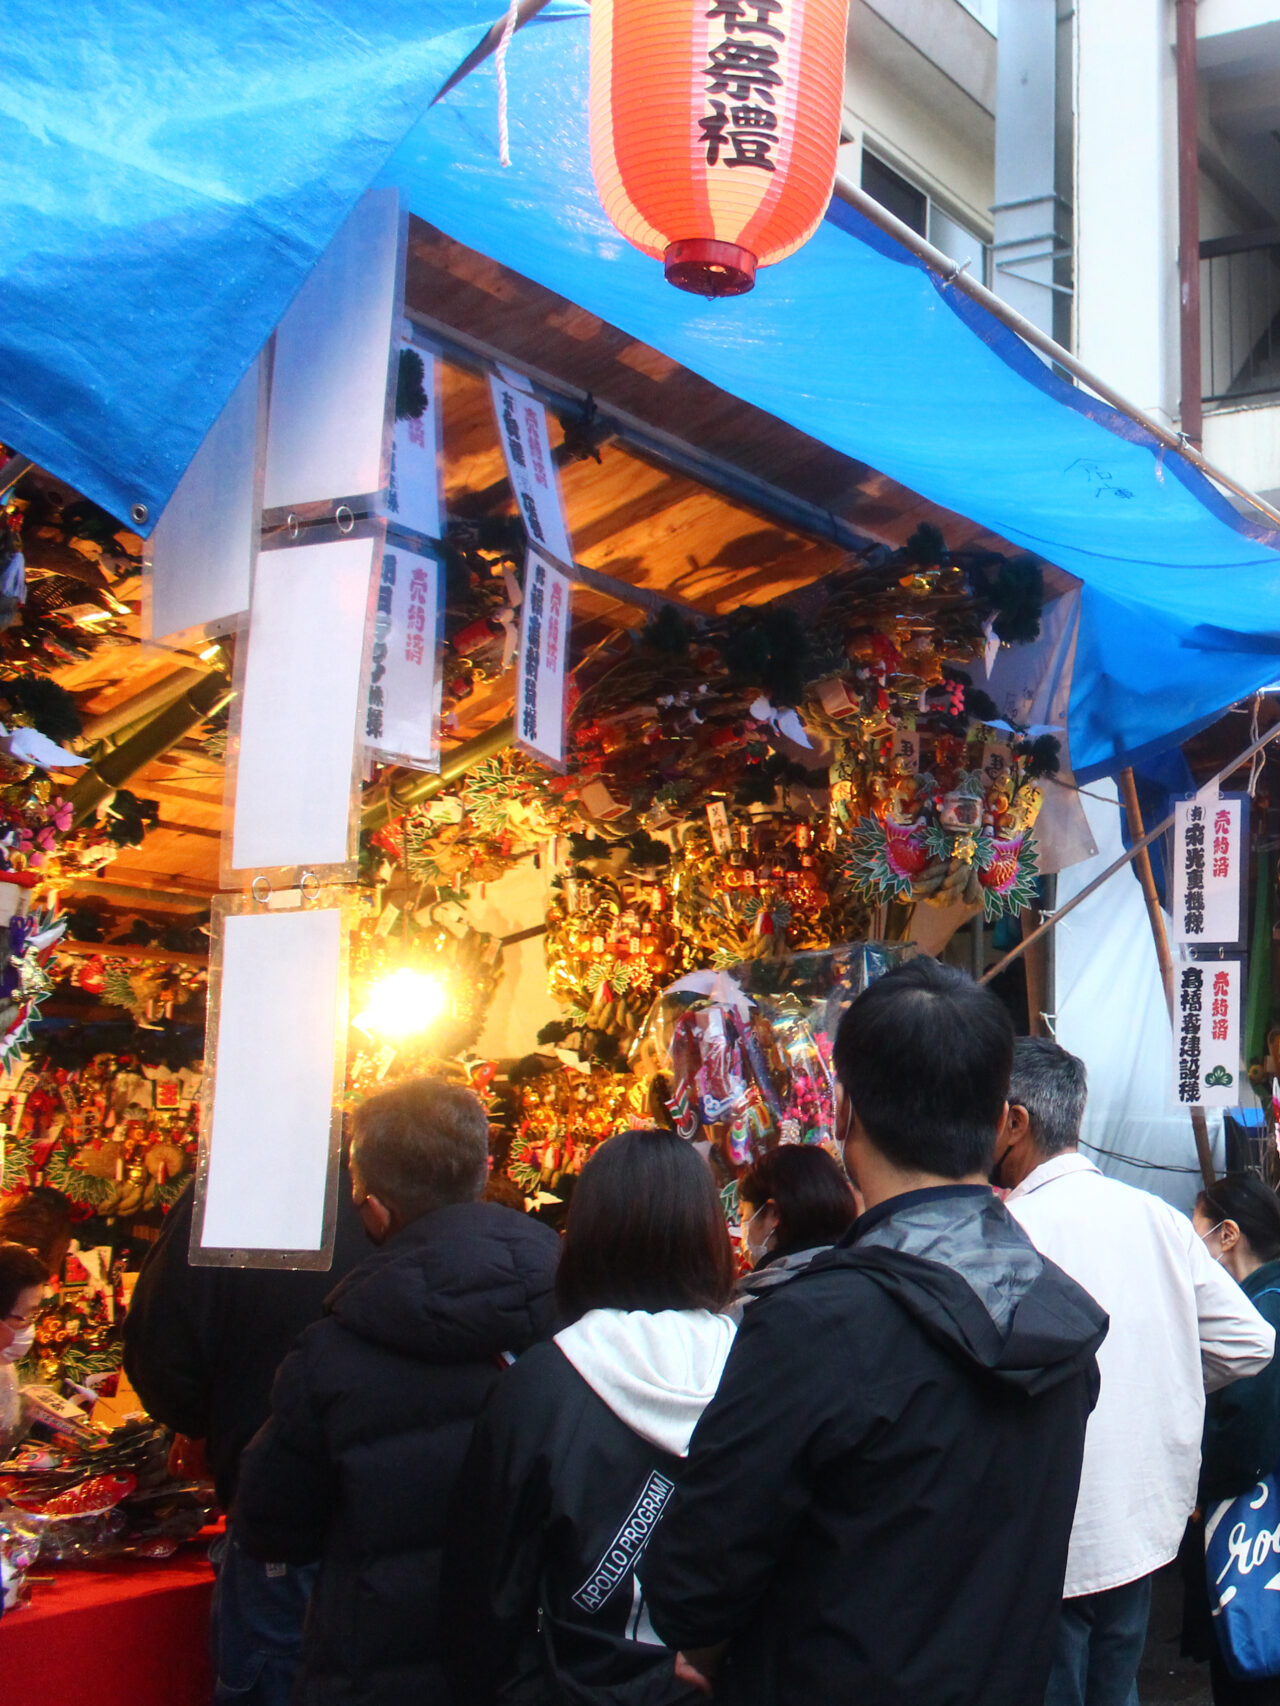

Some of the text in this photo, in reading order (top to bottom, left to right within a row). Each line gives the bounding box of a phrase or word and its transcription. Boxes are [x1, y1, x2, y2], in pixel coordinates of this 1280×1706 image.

[405, 567, 429, 666] 売約済
[1212, 809, 1232, 878] 売約済
[1211, 970, 1230, 1041] 売約済
[580, 1477, 670, 1609] APOLLO PROGRAM
